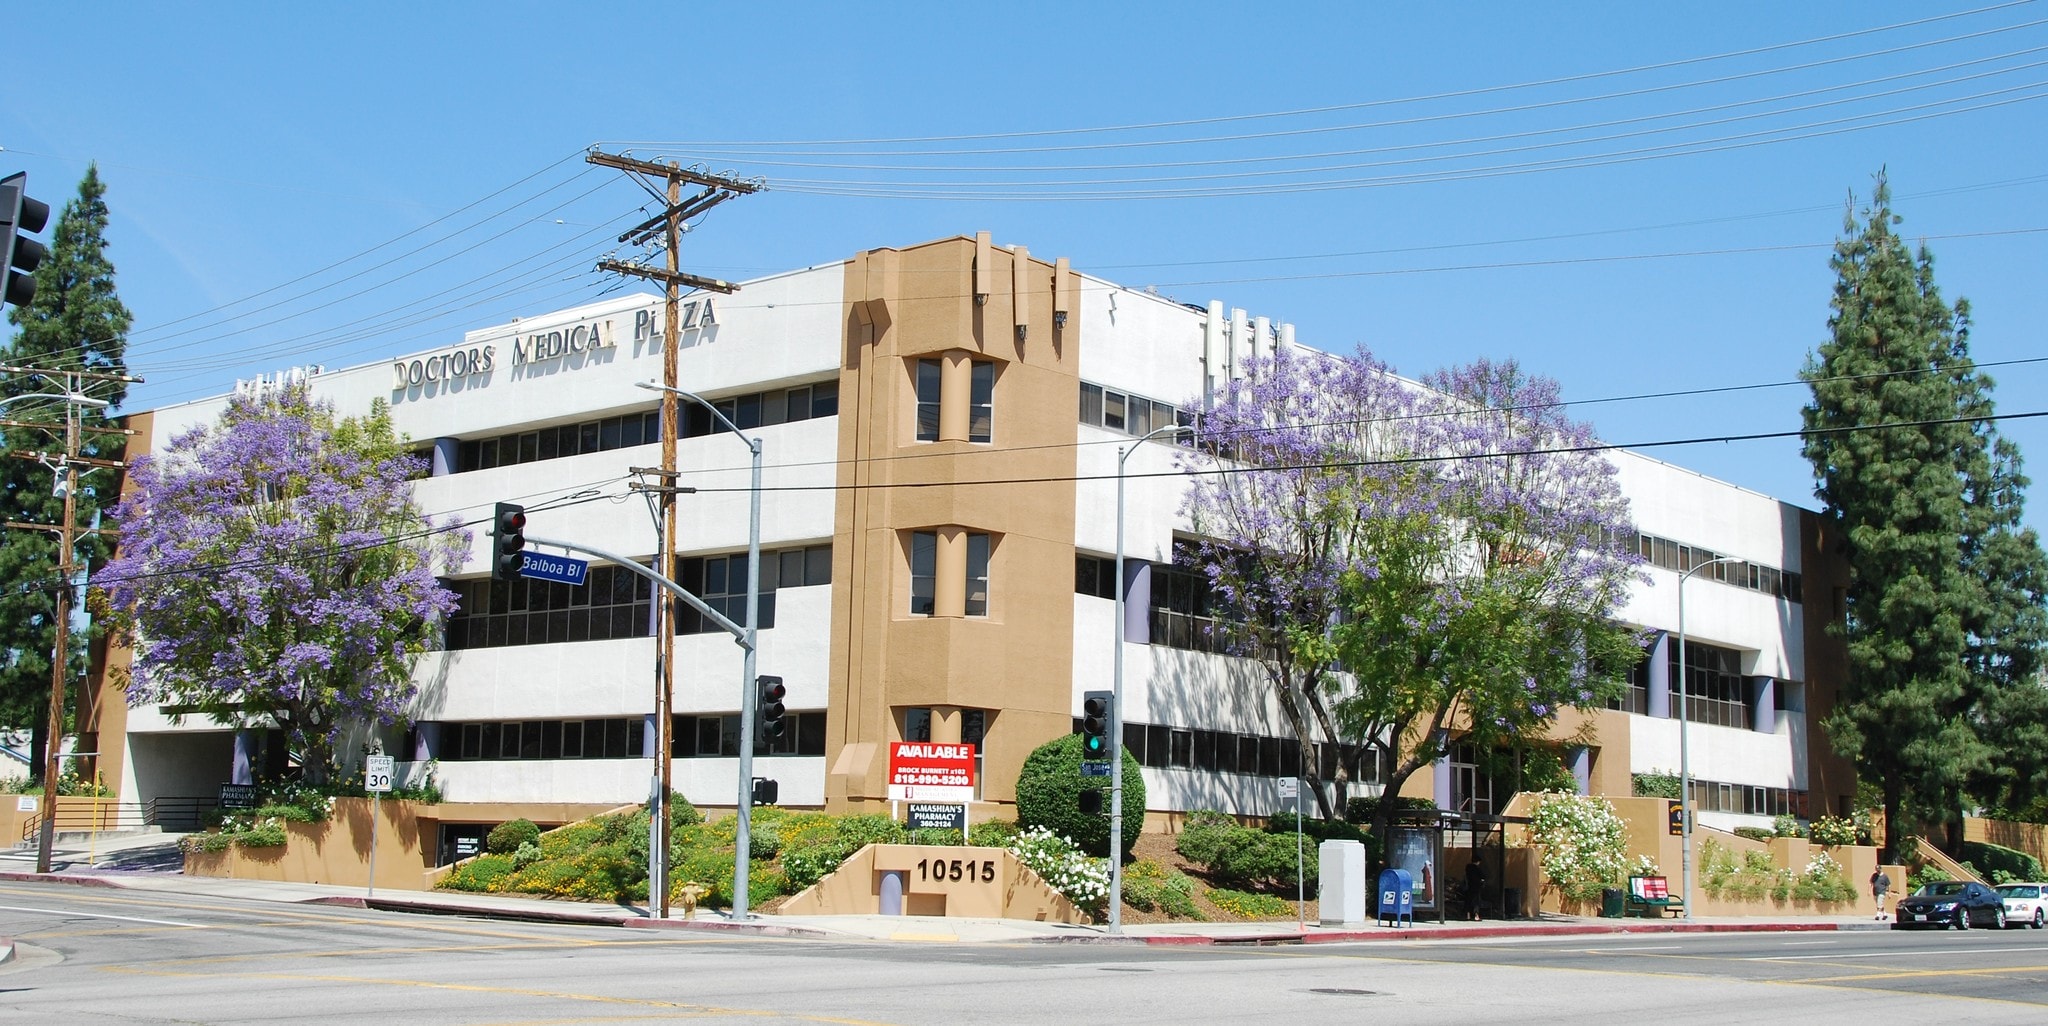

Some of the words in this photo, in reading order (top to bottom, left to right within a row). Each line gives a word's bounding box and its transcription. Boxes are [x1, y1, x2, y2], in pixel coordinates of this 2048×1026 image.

[393, 345, 496, 389] DOCTORS
[512, 320, 617, 367] MEDICAL
[634, 298, 720, 340] PLZA
[523, 556, 564, 575] Balboa
[567, 563, 581, 577] Bl
[896, 745, 969, 759] AVAILABLE
[921, 767, 950, 775] BURNETT
[370, 775, 389, 787] 30
[894, 774, 969, 785] 818-990-5200
[910, 804, 962, 813] KAMASHIAN'S
[917, 858, 995, 882] 10515
